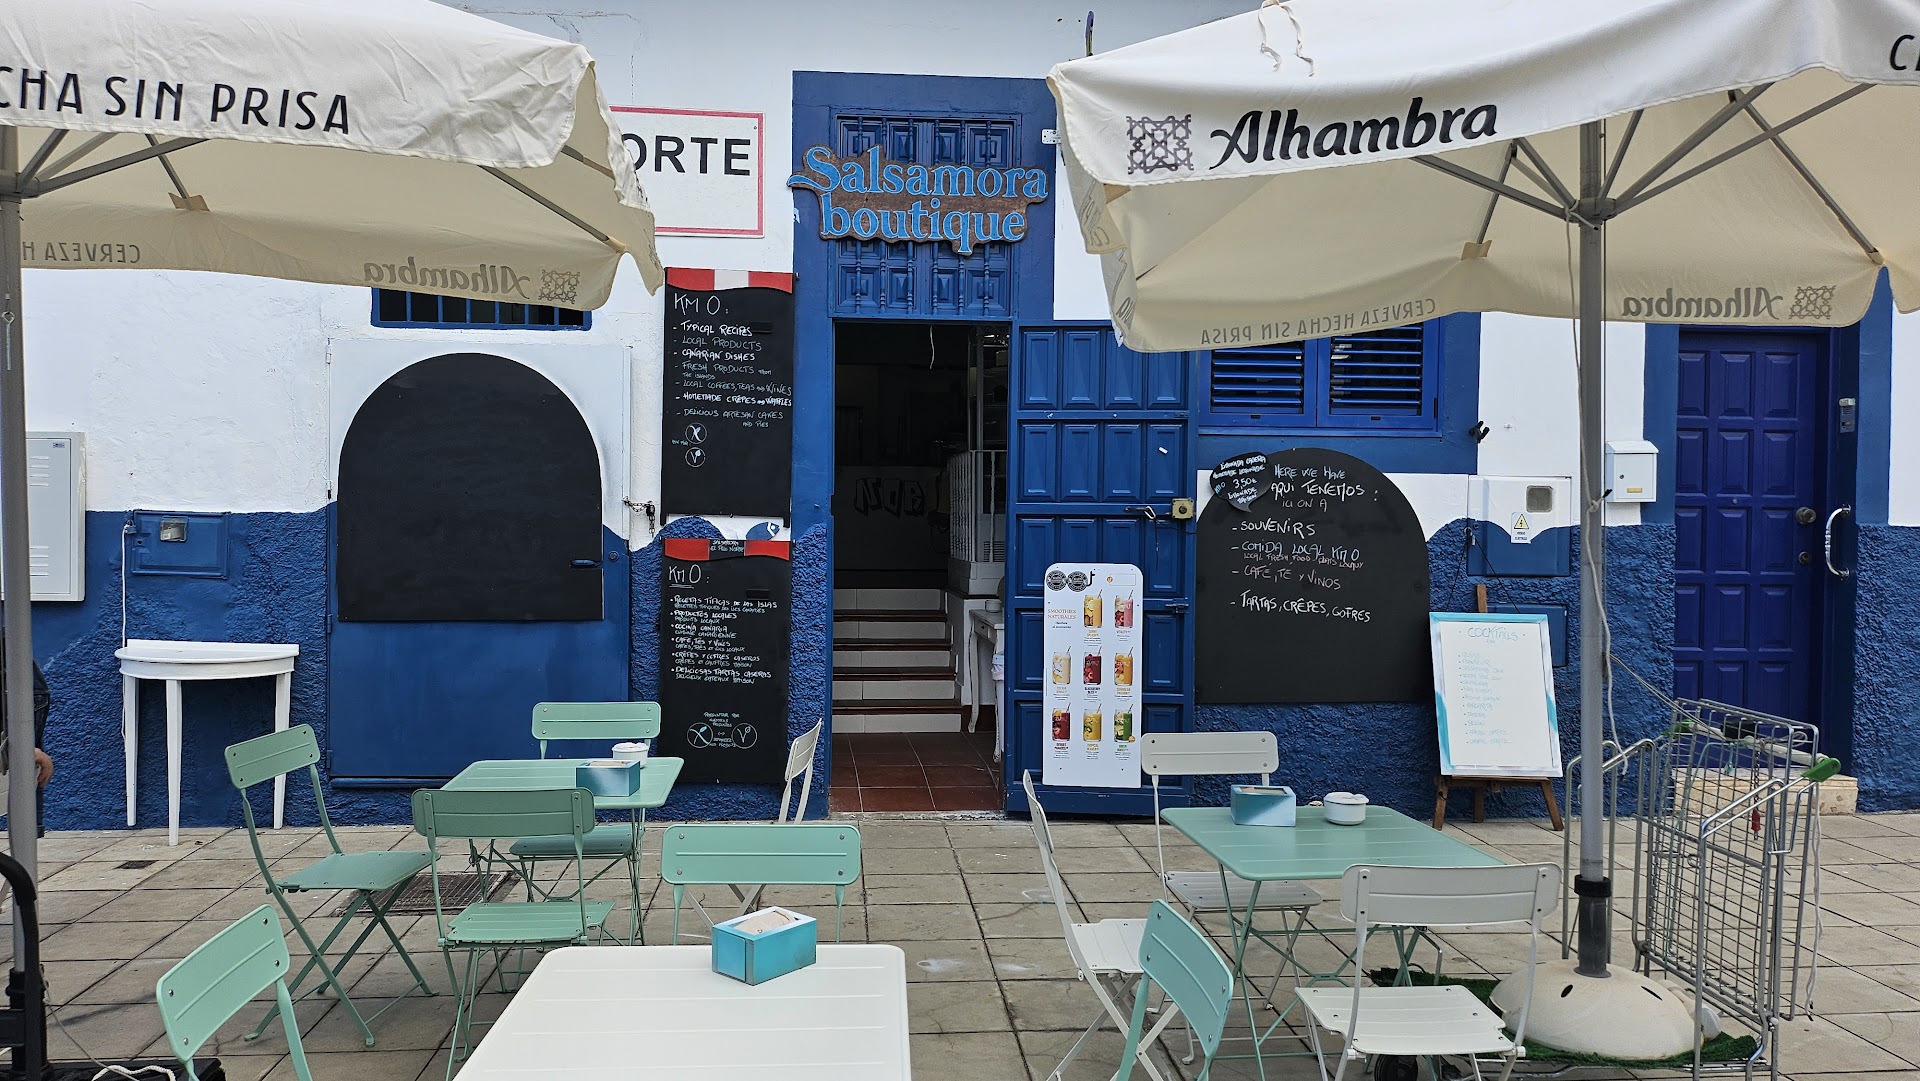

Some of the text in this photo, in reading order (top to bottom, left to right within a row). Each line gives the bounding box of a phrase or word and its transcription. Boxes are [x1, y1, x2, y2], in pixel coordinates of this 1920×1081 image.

[1889, 34, 1920, 71] C
[104, 76, 184, 121] SIN
[210, 83, 349, 135] PRISA
[1208, 96, 1498, 170] Alhambra
[621, 132, 751, 176] ORTE
[786, 145, 1048, 198] Salsamora
[820, 192, 1025, 253] boutique
[674, 292, 699, 315] KM
[680, 319, 715, 336] TYPICAL
[682, 335, 762, 352] LOCAL PRODUCTS
[681, 360, 708, 373] FRESH
[713, 363, 755, 374] PRODUCTS
[682, 380, 704, 388] LOCAL
[1274, 463, 1298, 479] HERE
[1301, 467, 1318, 478] WE
[1300, 479, 1366, 501] TENEMOS
[1297, 499, 1313, 508] ON
[1240, 517, 1316, 539] SOUVENIRS
[1241, 539, 1283, 558] COMIDA
[1291, 543, 1325, 560] LOCAL
[1307, 569, 1341, 590] VINOS
[1331, 606, 1371, 623] GOFRES
[1467, 625, 1519, 642] COCKTAILS
